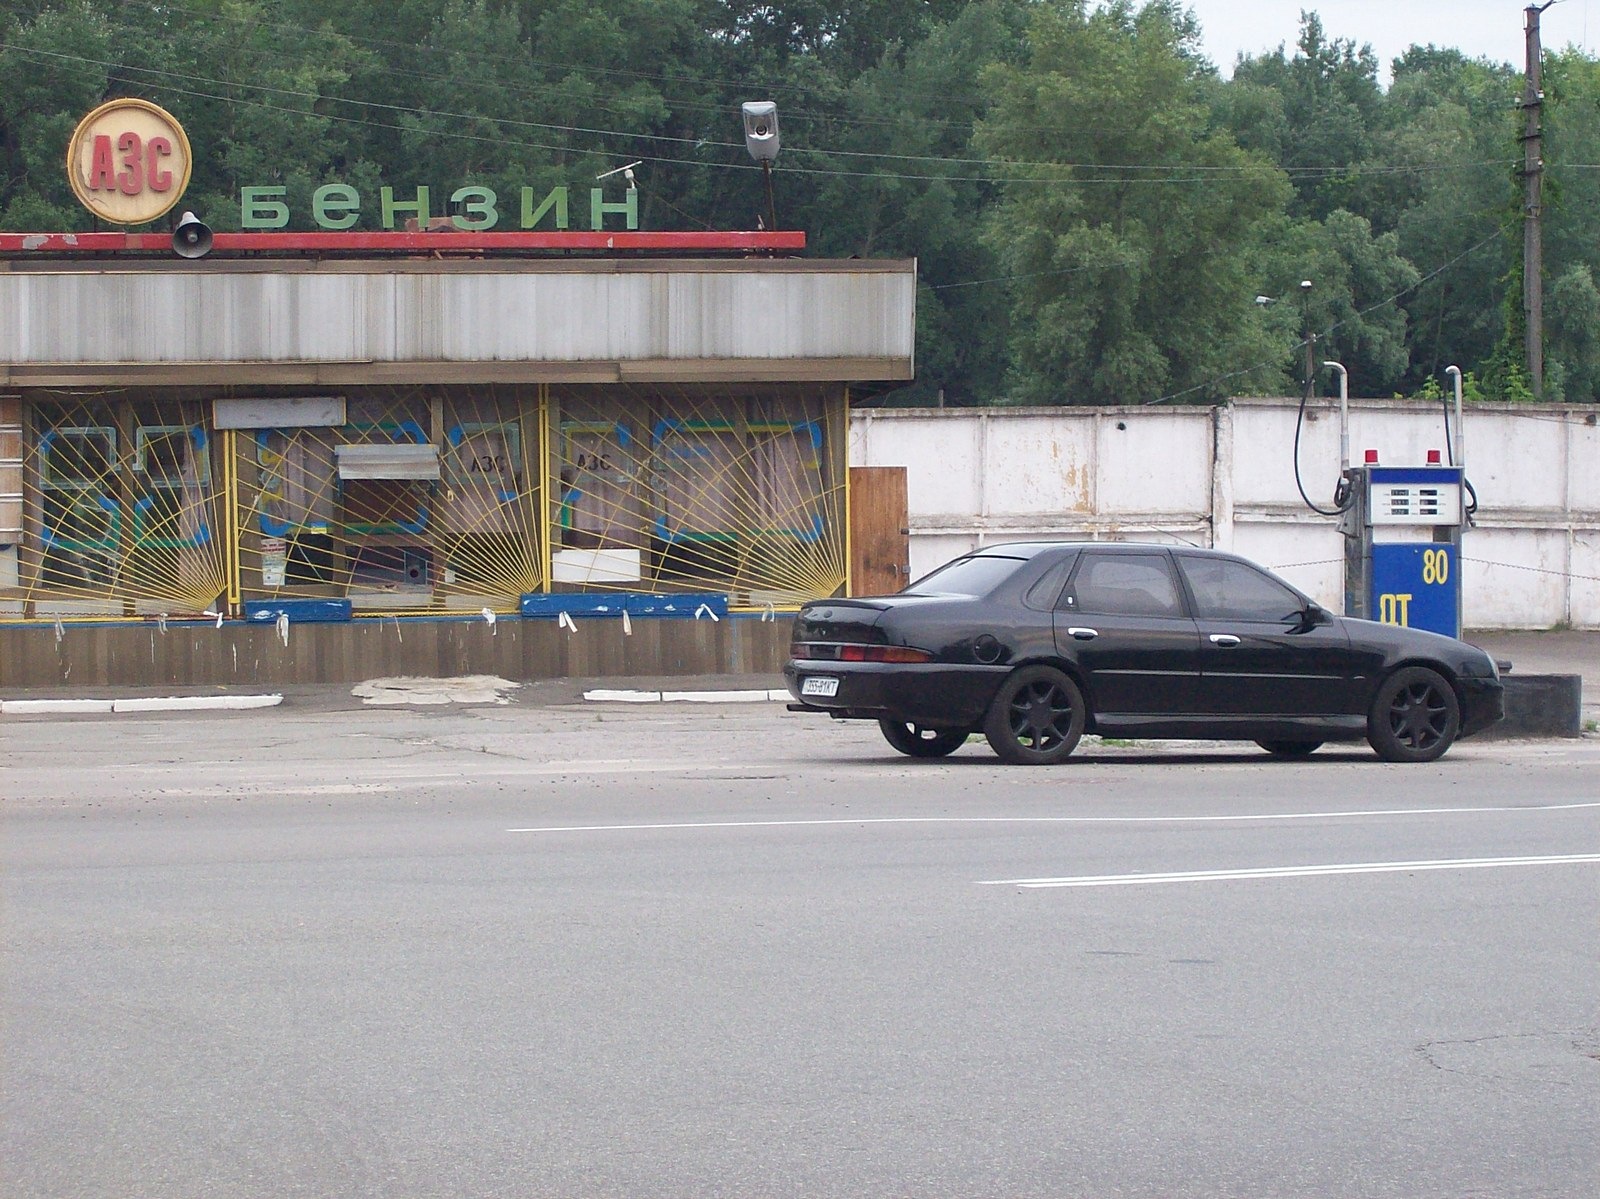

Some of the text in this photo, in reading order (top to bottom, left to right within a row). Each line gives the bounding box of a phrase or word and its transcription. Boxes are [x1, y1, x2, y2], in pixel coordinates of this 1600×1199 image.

[89, 131, 173, 196] АЗС
[240, 184, 639, 231] Бензин
[470, 455, 505, 473] АЗС
[575, 453, 612, 471] АЗС
[1423, 549, 1448, 585] 80
